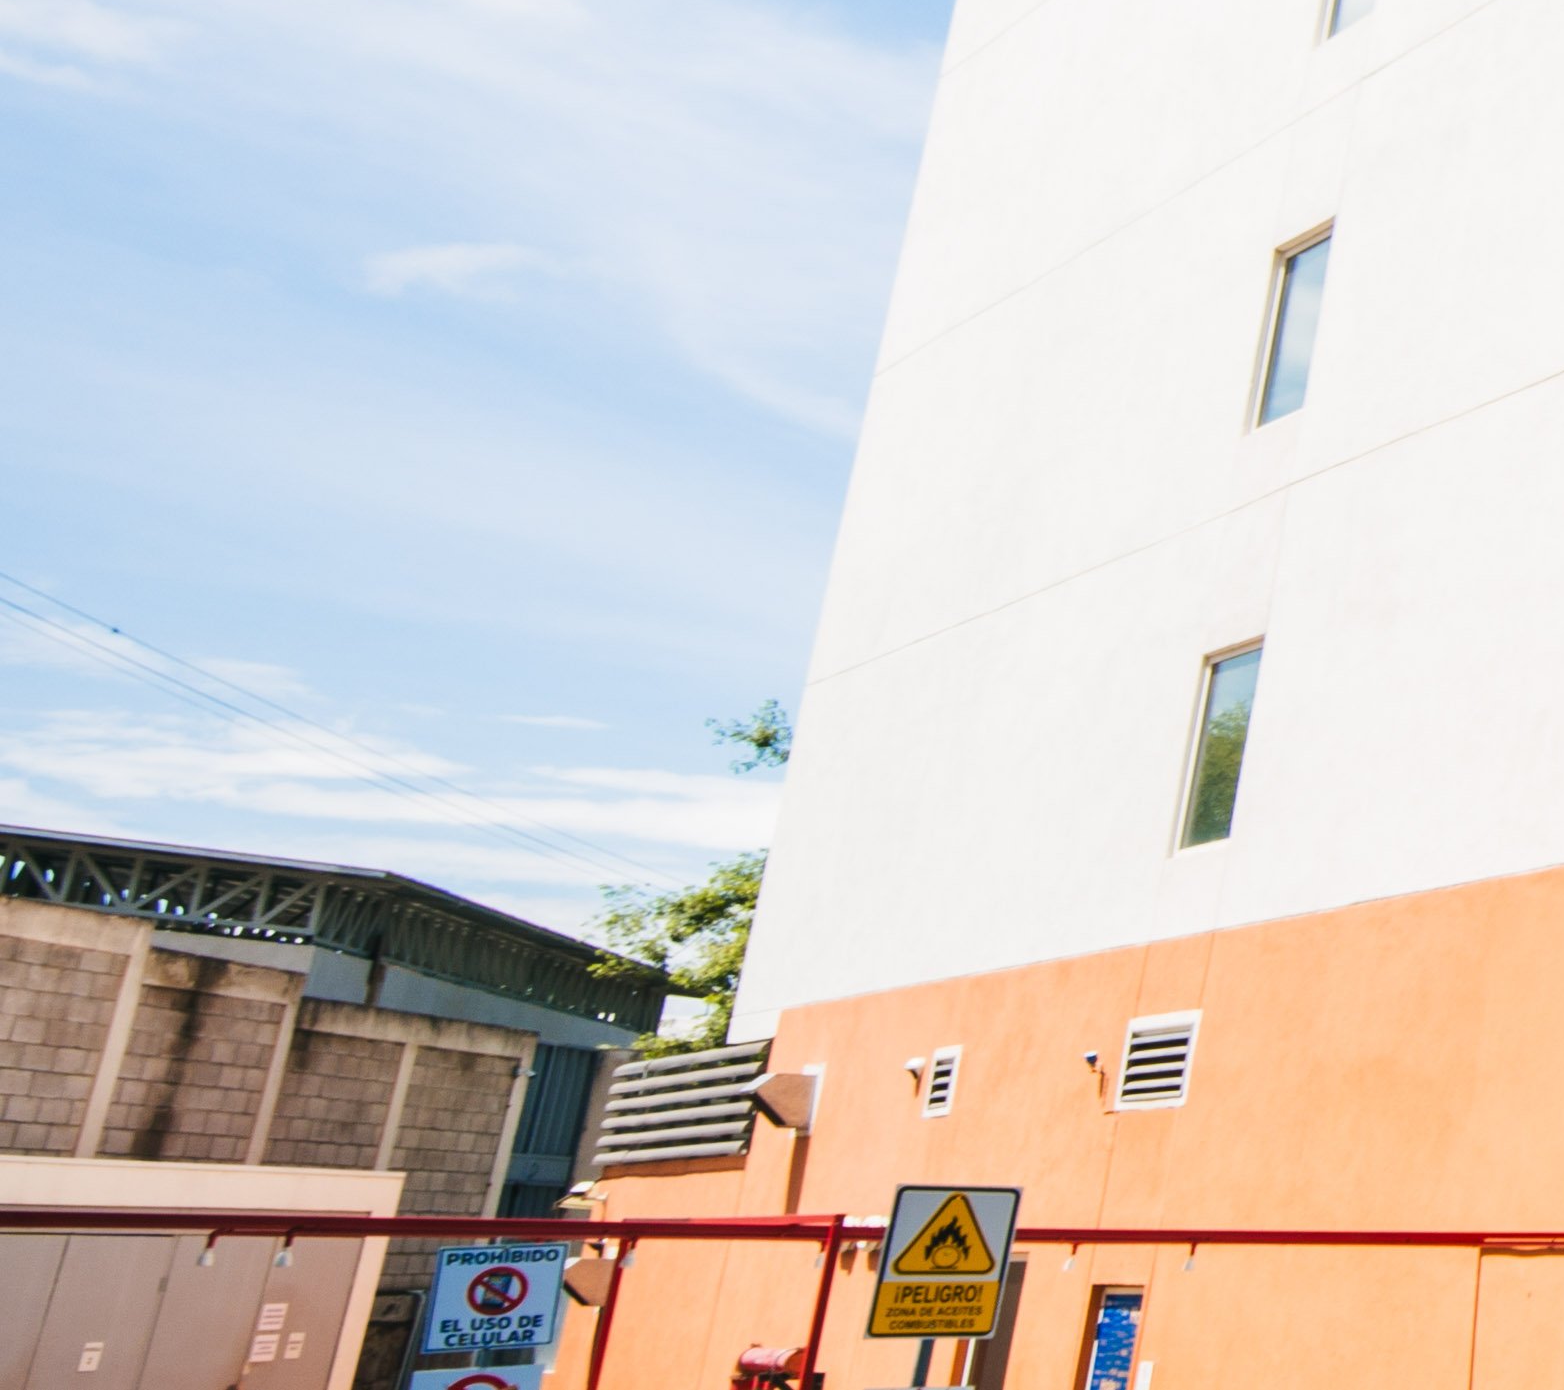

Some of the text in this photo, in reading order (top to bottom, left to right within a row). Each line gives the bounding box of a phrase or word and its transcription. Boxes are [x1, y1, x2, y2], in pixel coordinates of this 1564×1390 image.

[446, 1249, 559, 1265] PROHIBIDO
[885, 1305, 983, 1318] ZONA DE ACEITES
[440, 1314, 543, 1333] EL USO DE
[889, 1319, 975, 1330] COMBUSTIBLES
[444, 1330, 535, 1347] CELULAR
